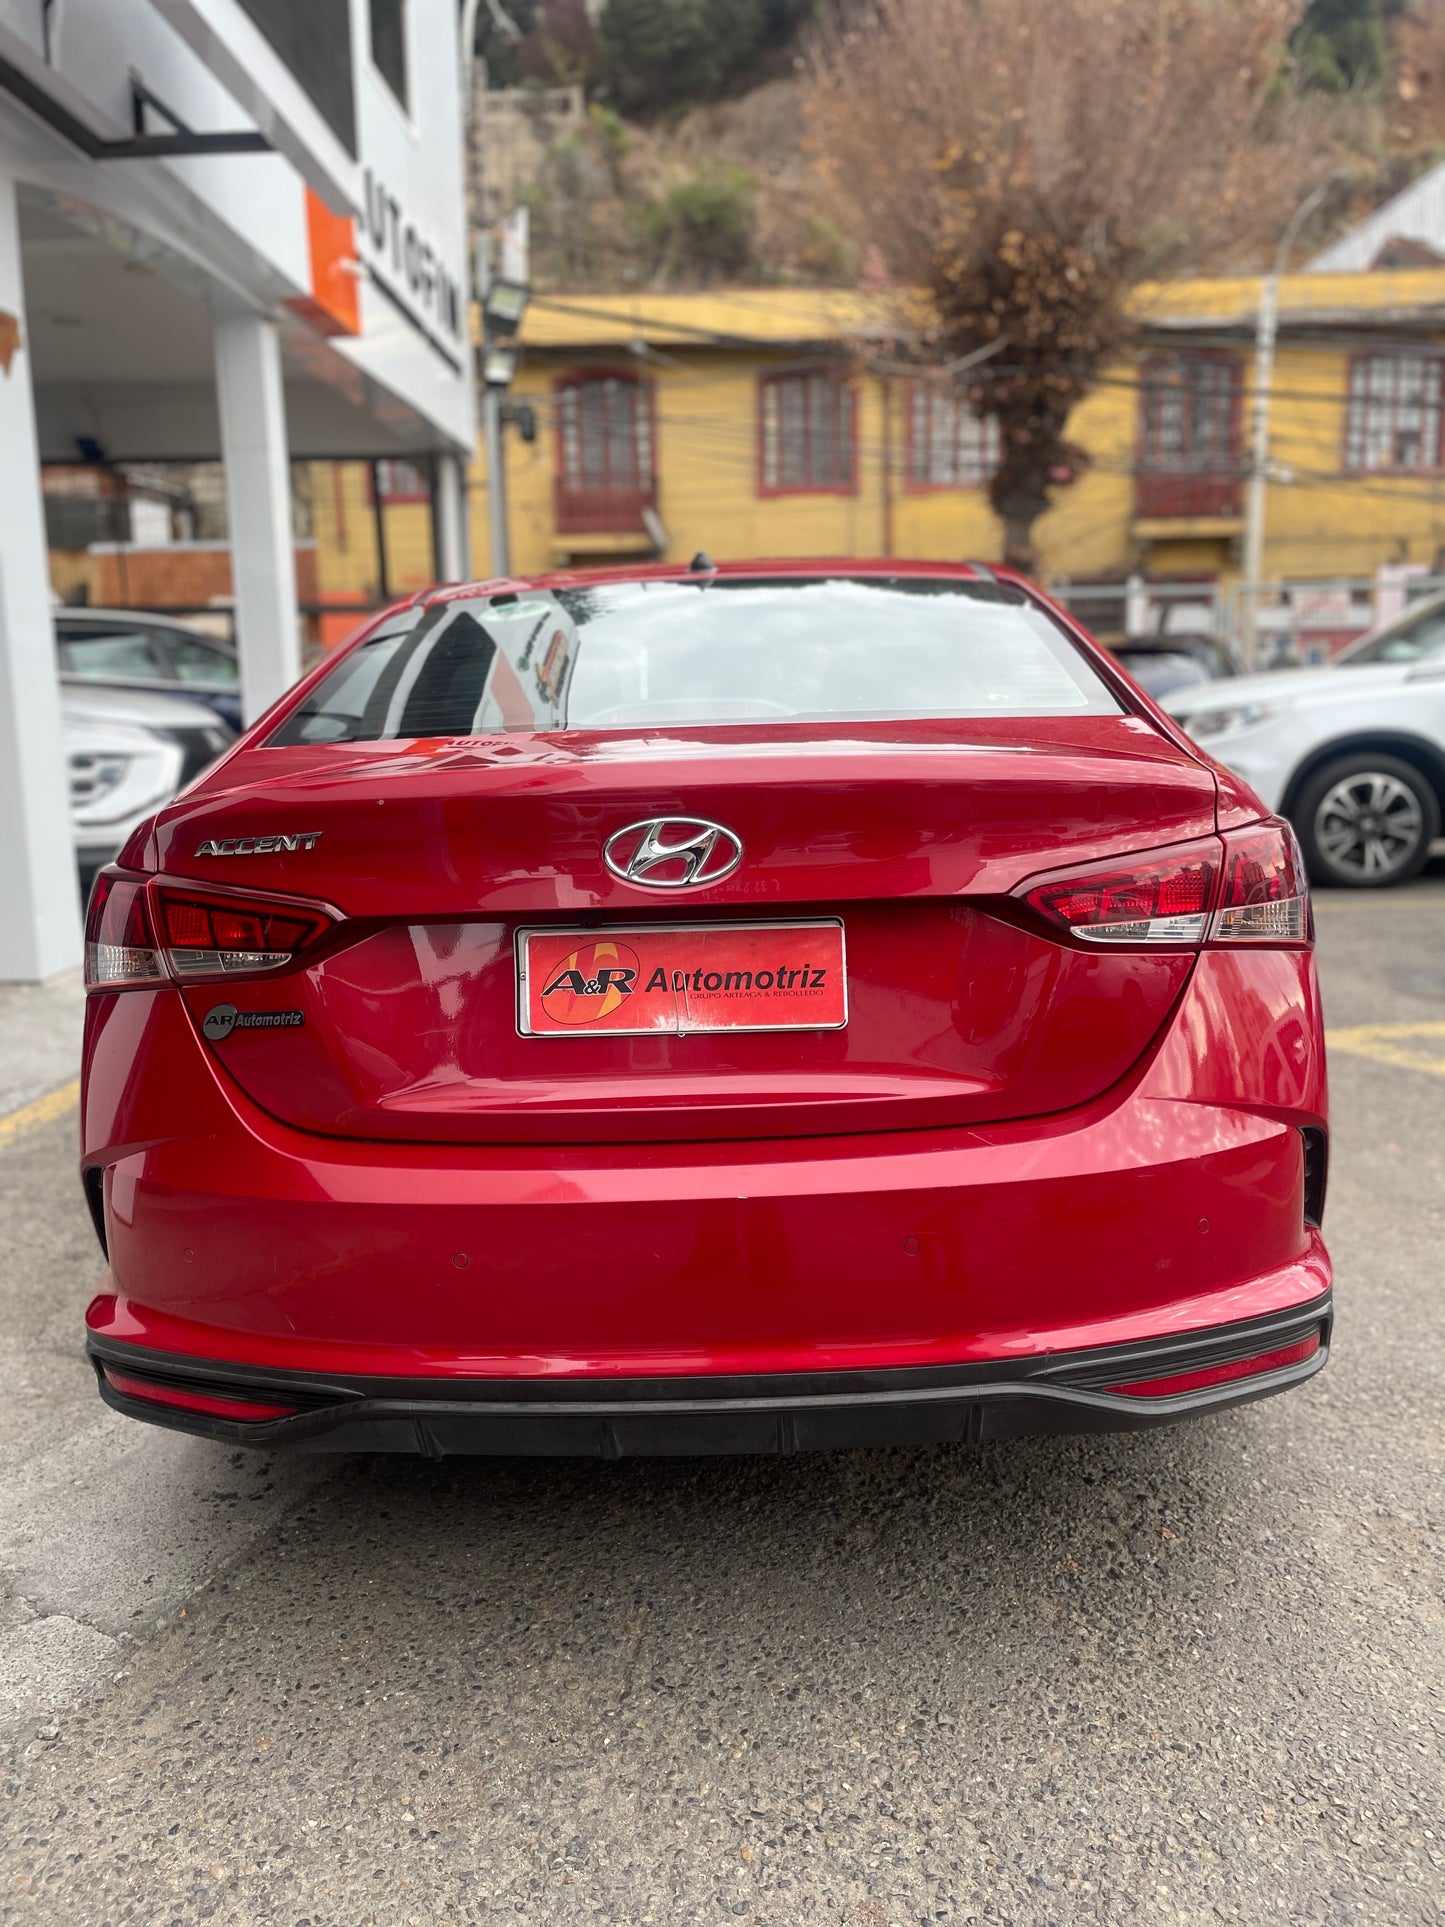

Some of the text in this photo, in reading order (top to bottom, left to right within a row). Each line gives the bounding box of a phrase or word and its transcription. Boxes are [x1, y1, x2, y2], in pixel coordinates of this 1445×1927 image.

[193, 830, 323, 857] ACCENT
[540, 963, 827, 997] A&R Automotriz
[689, 992, 721, 1000] GRUPO
[773, 989, 824, 998] REBOLLEDO
[204, 1012, 302, 1027] AR Automotriz
